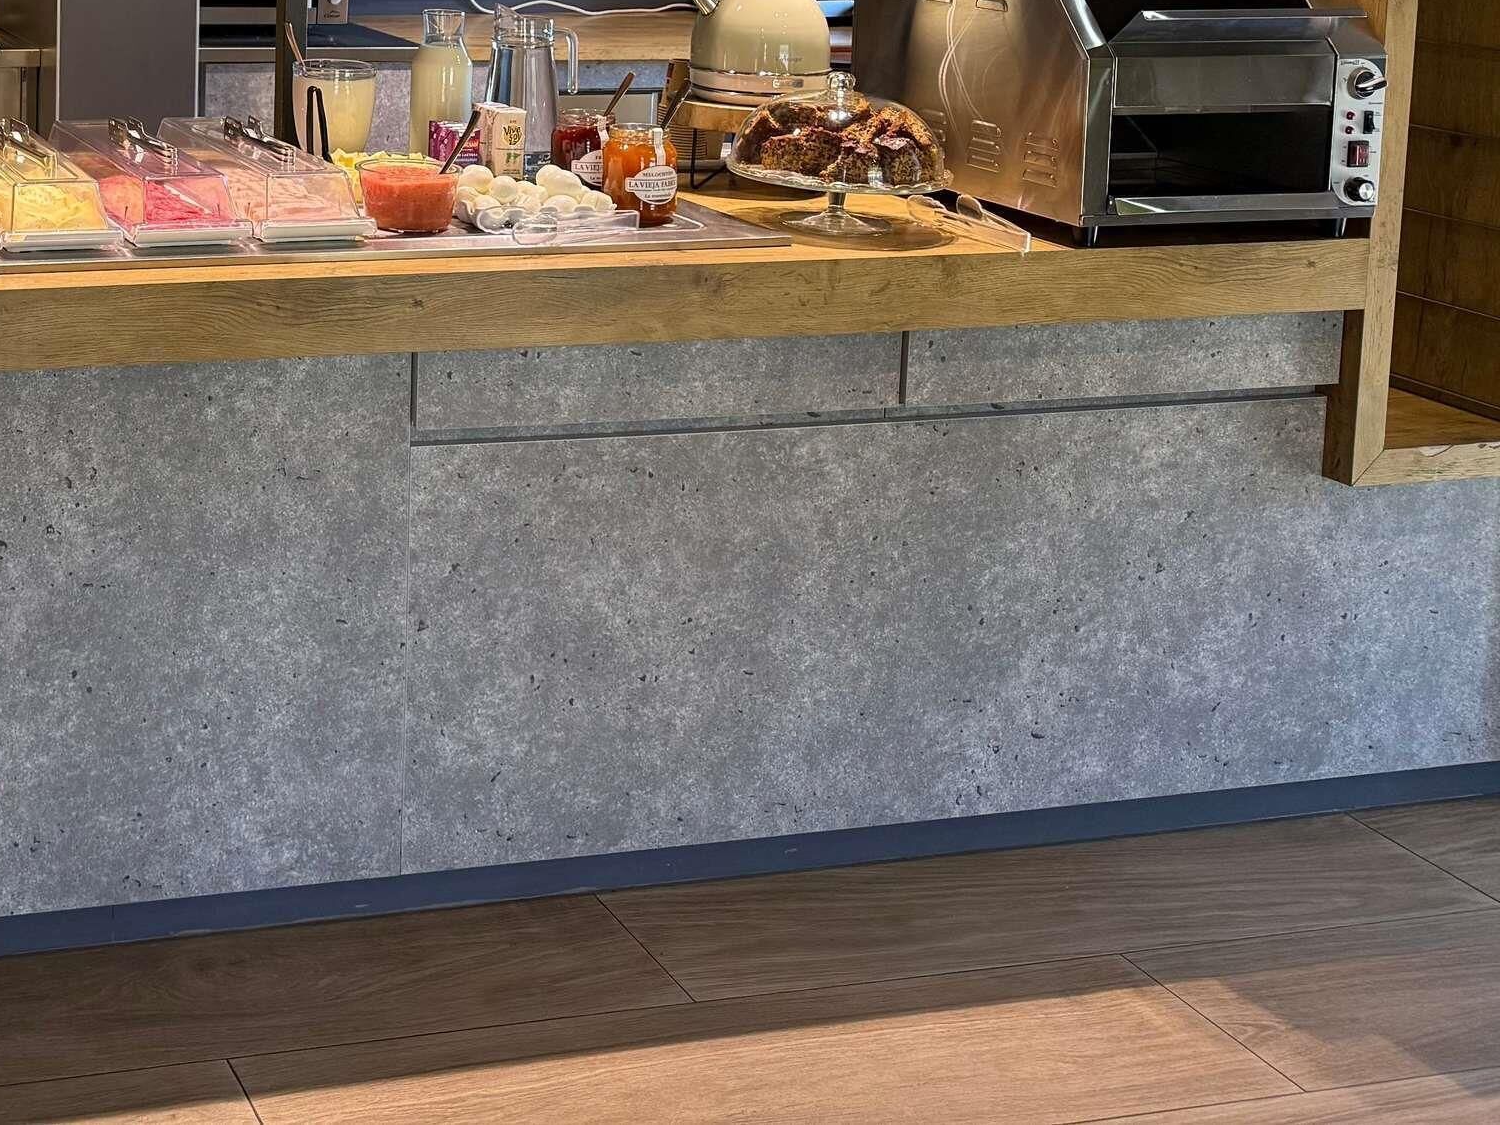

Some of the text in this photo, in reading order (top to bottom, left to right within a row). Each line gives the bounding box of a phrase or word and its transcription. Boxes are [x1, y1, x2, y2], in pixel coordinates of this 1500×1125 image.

[574, 163, 584, 171] LA
[628, 181, 639, 189] LA
[640, 180, 660, 189] VIEJA
